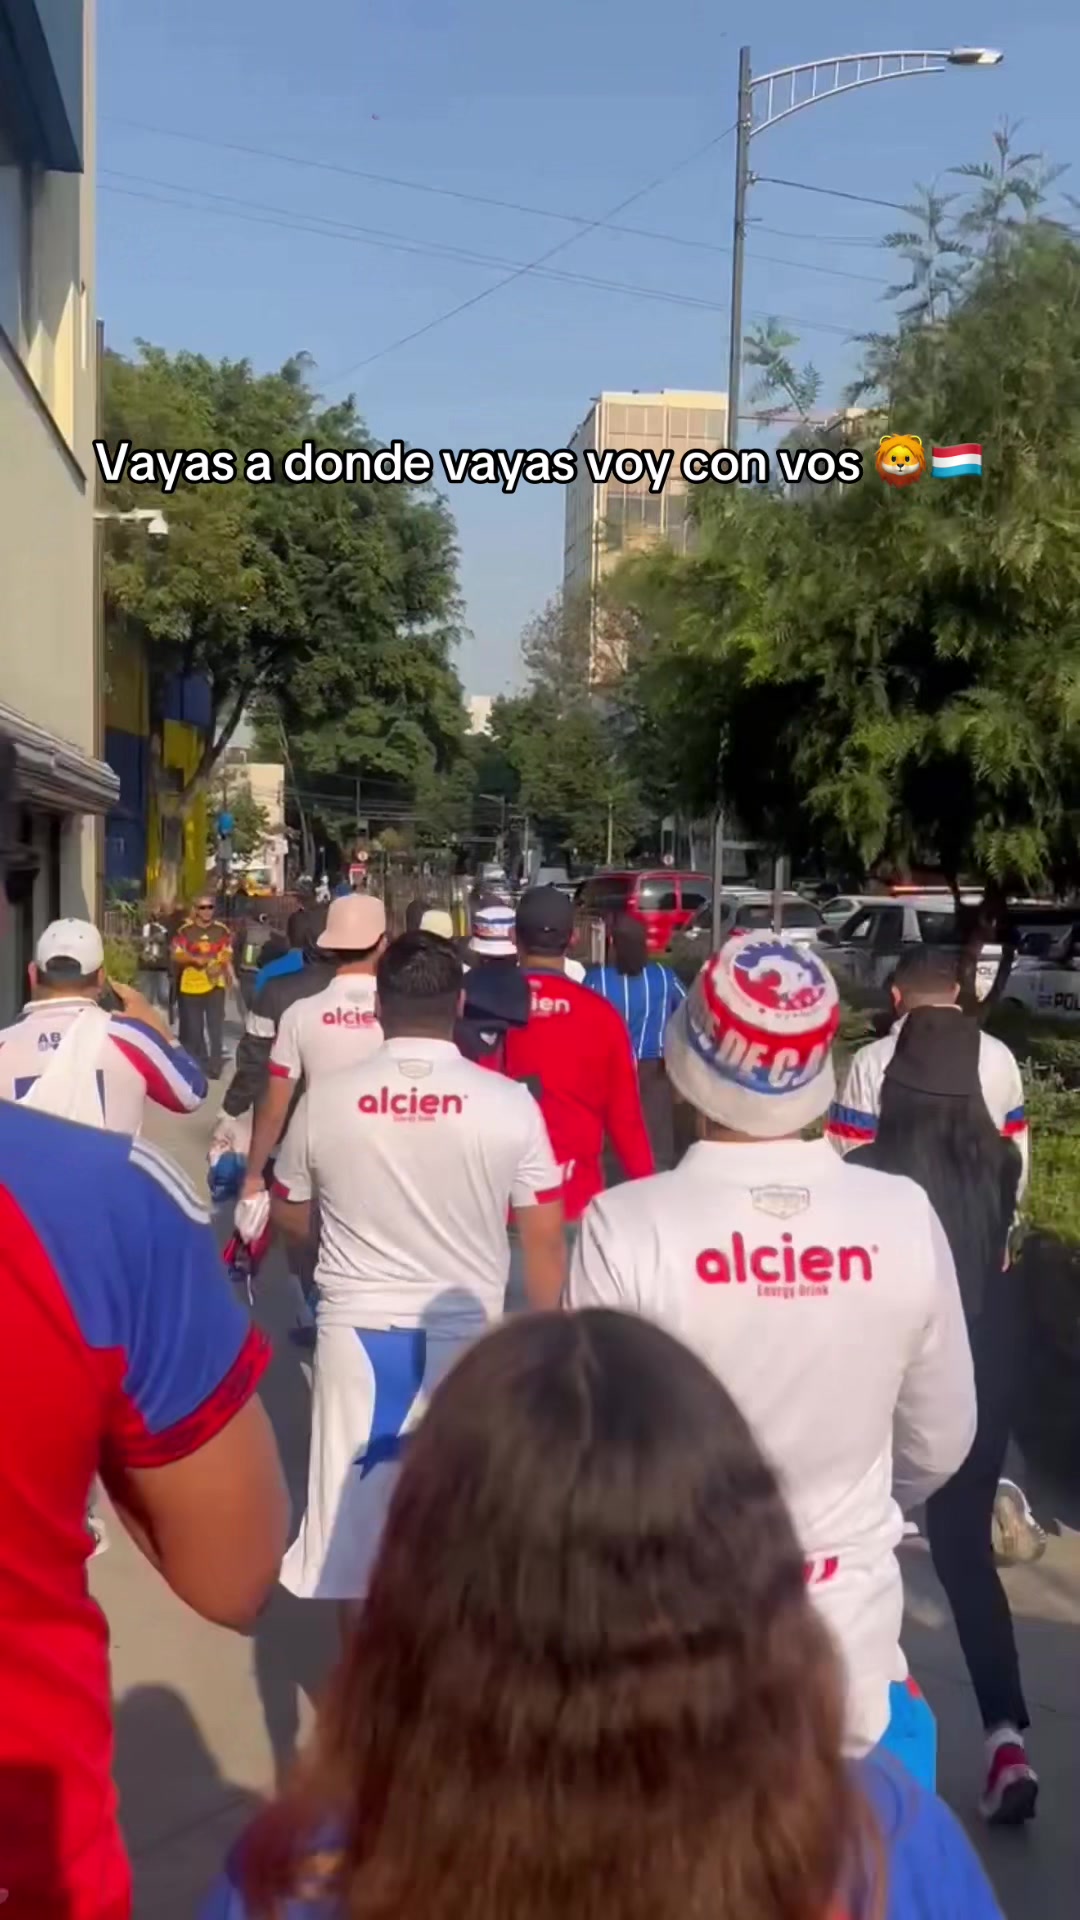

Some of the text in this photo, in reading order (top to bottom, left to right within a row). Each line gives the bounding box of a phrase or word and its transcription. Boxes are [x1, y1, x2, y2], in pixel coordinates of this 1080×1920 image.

[322, 1006, 377, 1025] alcie
[530, 991, 571, 1014] ien
[358, 1085, 463, 1115] alcien
[695, 1230, 873, 1285] alcien
